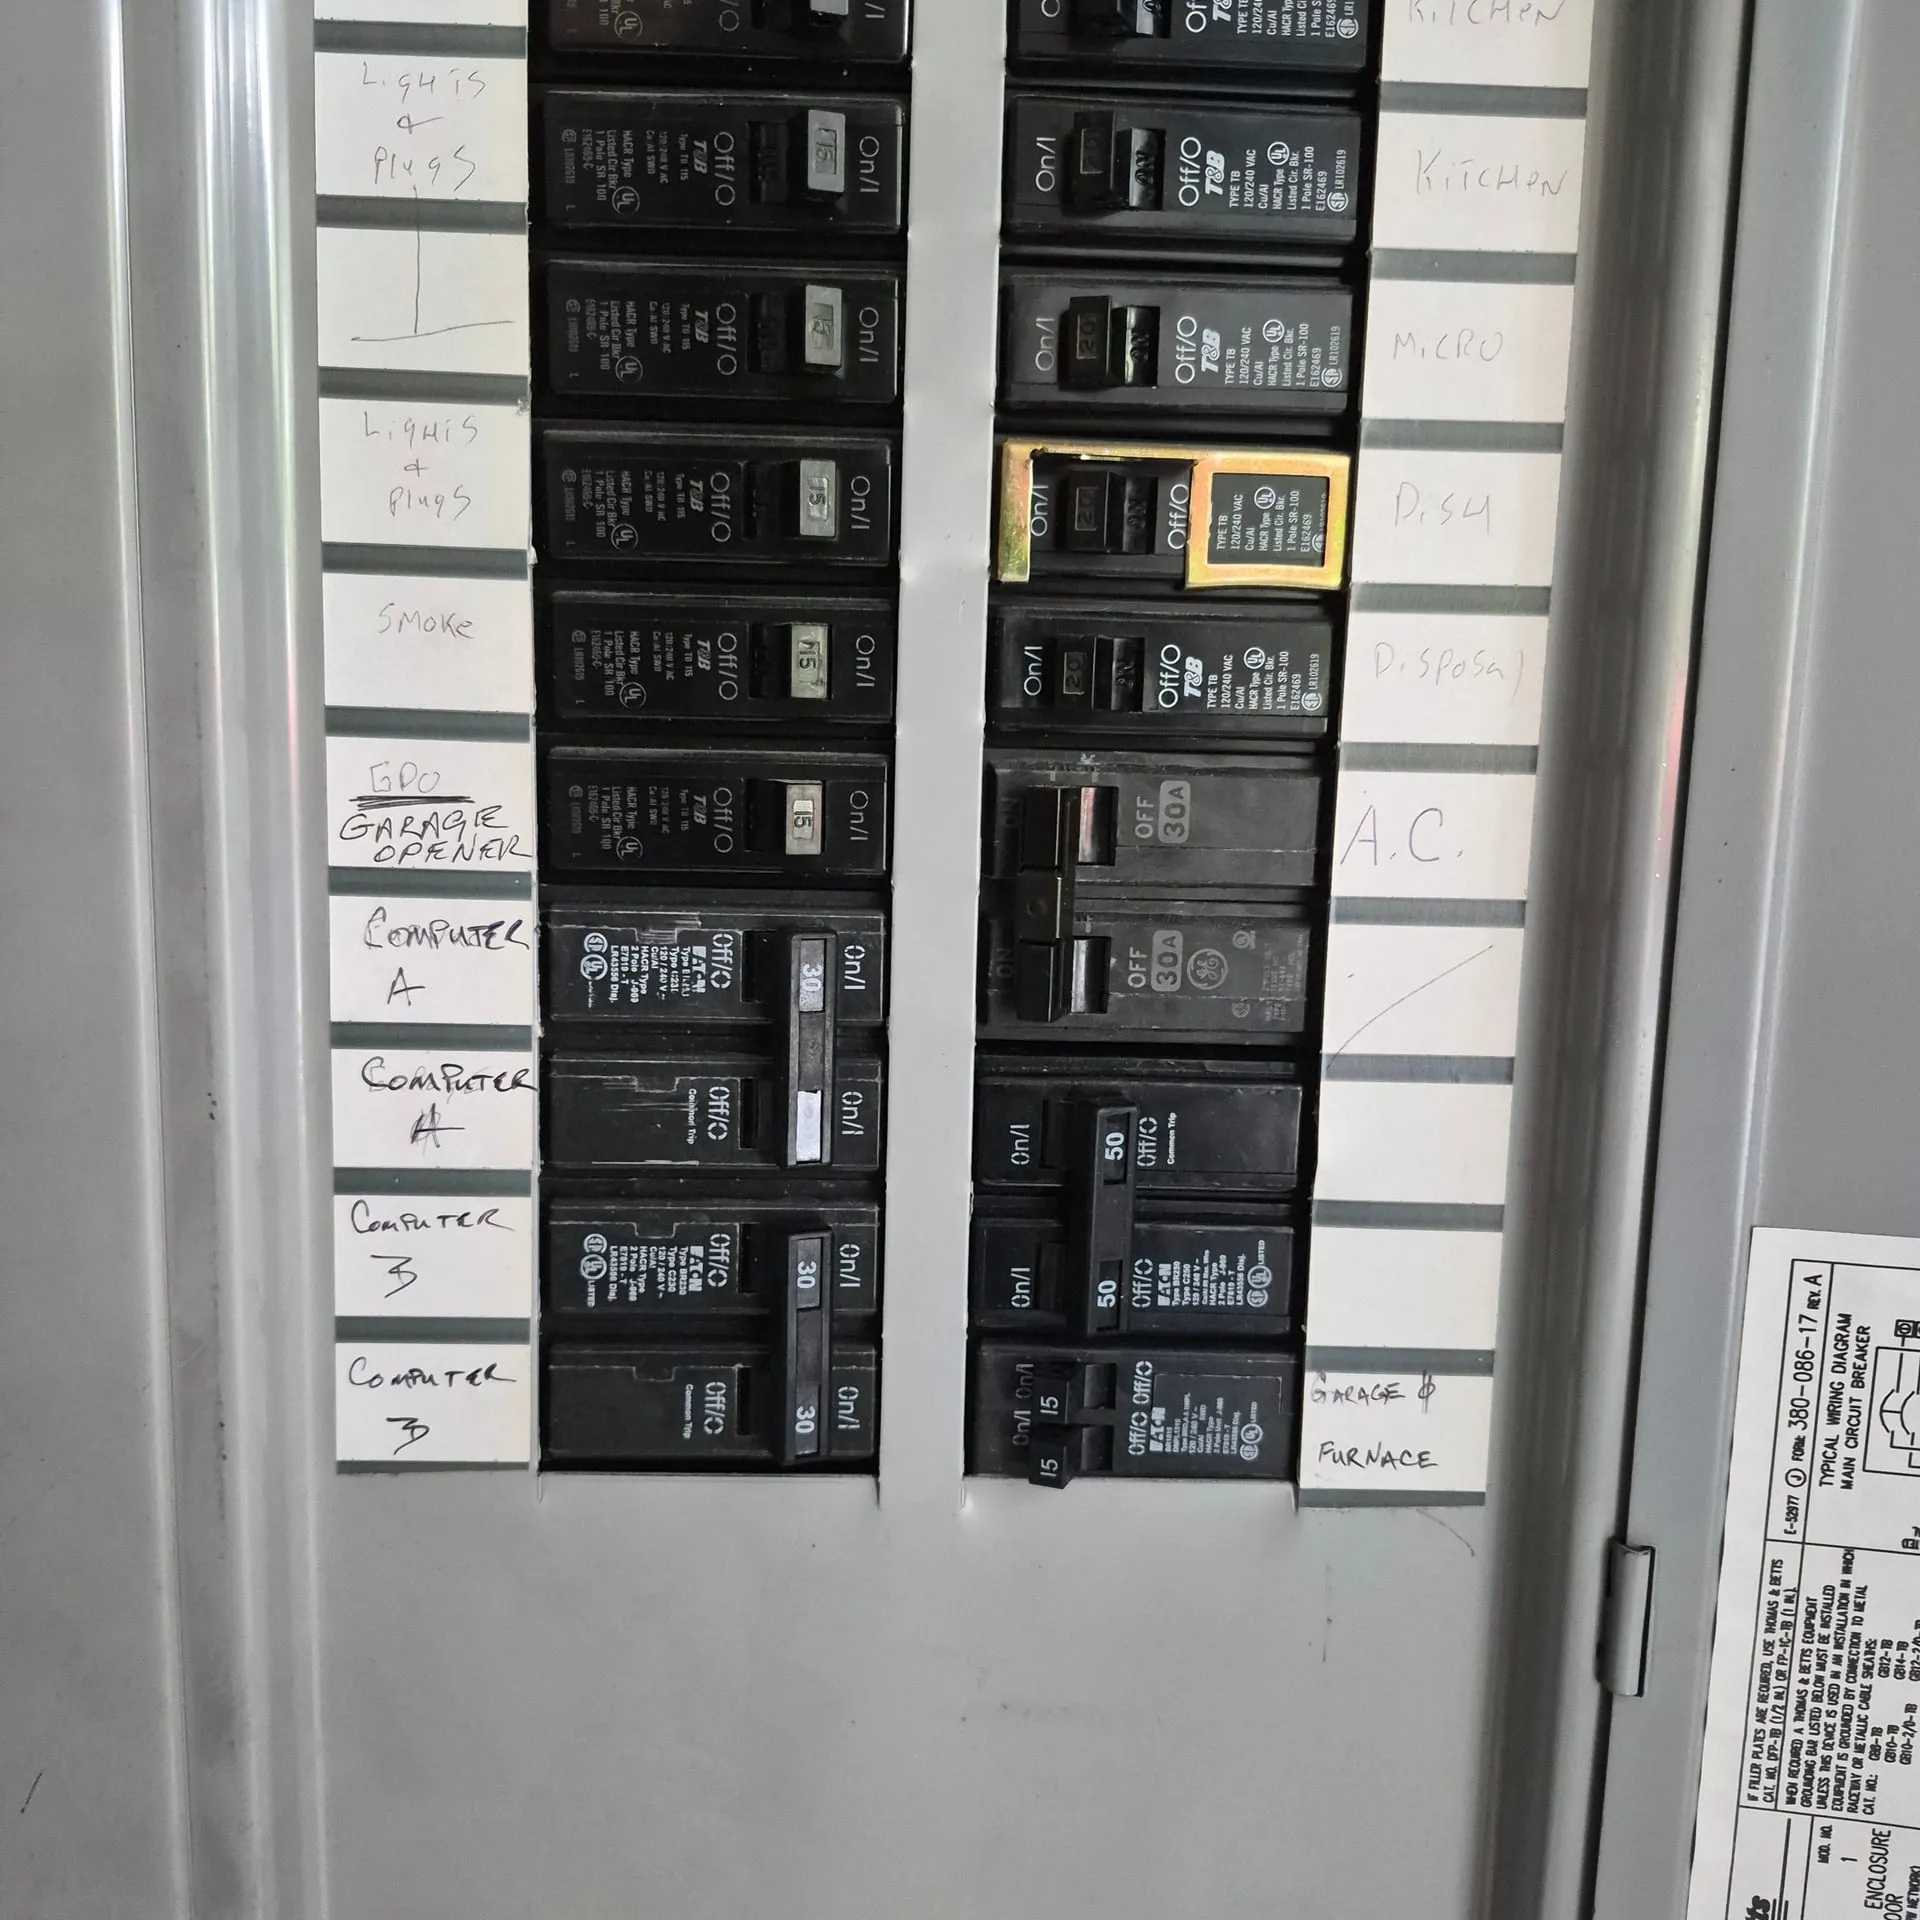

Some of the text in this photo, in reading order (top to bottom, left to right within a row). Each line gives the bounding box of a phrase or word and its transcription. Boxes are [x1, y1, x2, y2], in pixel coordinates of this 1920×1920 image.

[1205, 150, 1224, 195] T&B
[1244, 149, 1256, 207] 120/240 VAC
[1302, 146, 1314, 202] Pole SR-100
[1335, 149, 1346, 189] LR102619
[1229, 171, 1240, 208] TYPE TB
[1272, 168, 1286, 209] HACR Type
[1287, 185, 1298, 210] Listed
[1316, 171, 1328, 211] E162469
[798, 649, 818, 672] 15
[1184, 656, 1203, 697] T&B
[1277, 652, 1289, 702] Pole SR-100
[1309, 654, 1319, 690] LR102619
[1207, 674, 1218, 709] TYPE TB
[1221, 654, 1233, 708] 120/240 VAC
[1249, 672, 1260, 709] HACR Type
[1263, 688, 1273, 710] Listed
[1290, 674, 1301, 710] E162469
[340, 805, 509, 842] GARAGE
[793, 811, 812, 829] 15
[1135, 796, 1154, 839] OFF
[1163, 786, 1186, 837] 30A
[374, 834, 532, 864] OPENER
[1341, 805, 1463, 866] A.C.
[802, 963, 824, 993] 30
[1127, 947, 1147, 988] OFF
[1155, 935, 1177, 986] 30A
[388, 966, 426, 1006] A
[688, 1125, 696, 1144] Trip
[1105, 1132, 1124, 1161] 50
[1167, 1112, 1177, 1164] Common Trip
[797, 1261, 818, 1289] 30
[1097, 1280, 1117, 1307] 50
[1803, 1274, 1822, 1286] A
[1807, 1290, 1821, 1309] REV.
[1311, 1371, 1405, 1405] GARAGE
[1788, 1314, 1818, 1430] 380-086-17
[683, 1384, 694, 1438] Common Trip
[1040, 1396, 1059, 1415] 15
[1819, 1313, 1852, 1487] TYPICAL WIRING DIAGRAM
[1840, 1325, 1871, 1489] MAIN CIRCUIT BREAKER
[795, 1406, 816, 1434] 30
[1040, 1459, 1058, 1477] 15
[1318, 1441, 1437, 1469] FURNACE
[1784, 1495, 1799, 1535] E-52977
[1769, 1559, 1783, 1586] BETTS
[1768, 1588, 1780, 1596] &
[1764, 1601, 1779, 1634] THOMAS
[1762, 1639, 1775, 1656] USE
[1894, 1641, 1909, 1680] GB14-TB
[1756, 1706, 1768, 1724] ARE
[1862, 1796, 1876, 1815] CAT.
[1878, 1639, 1893, 1678] GB12-TB
[1751, 1728, 1766, 1760] PLATES
[1762, 1785, 1775, 1803] CAT.
[1775, 1669, 1787, 1681] OR
[1748, 1763, 1761, 1790] FILLER
[1864, 1828, 1891, 1910] ENCLOSURE
